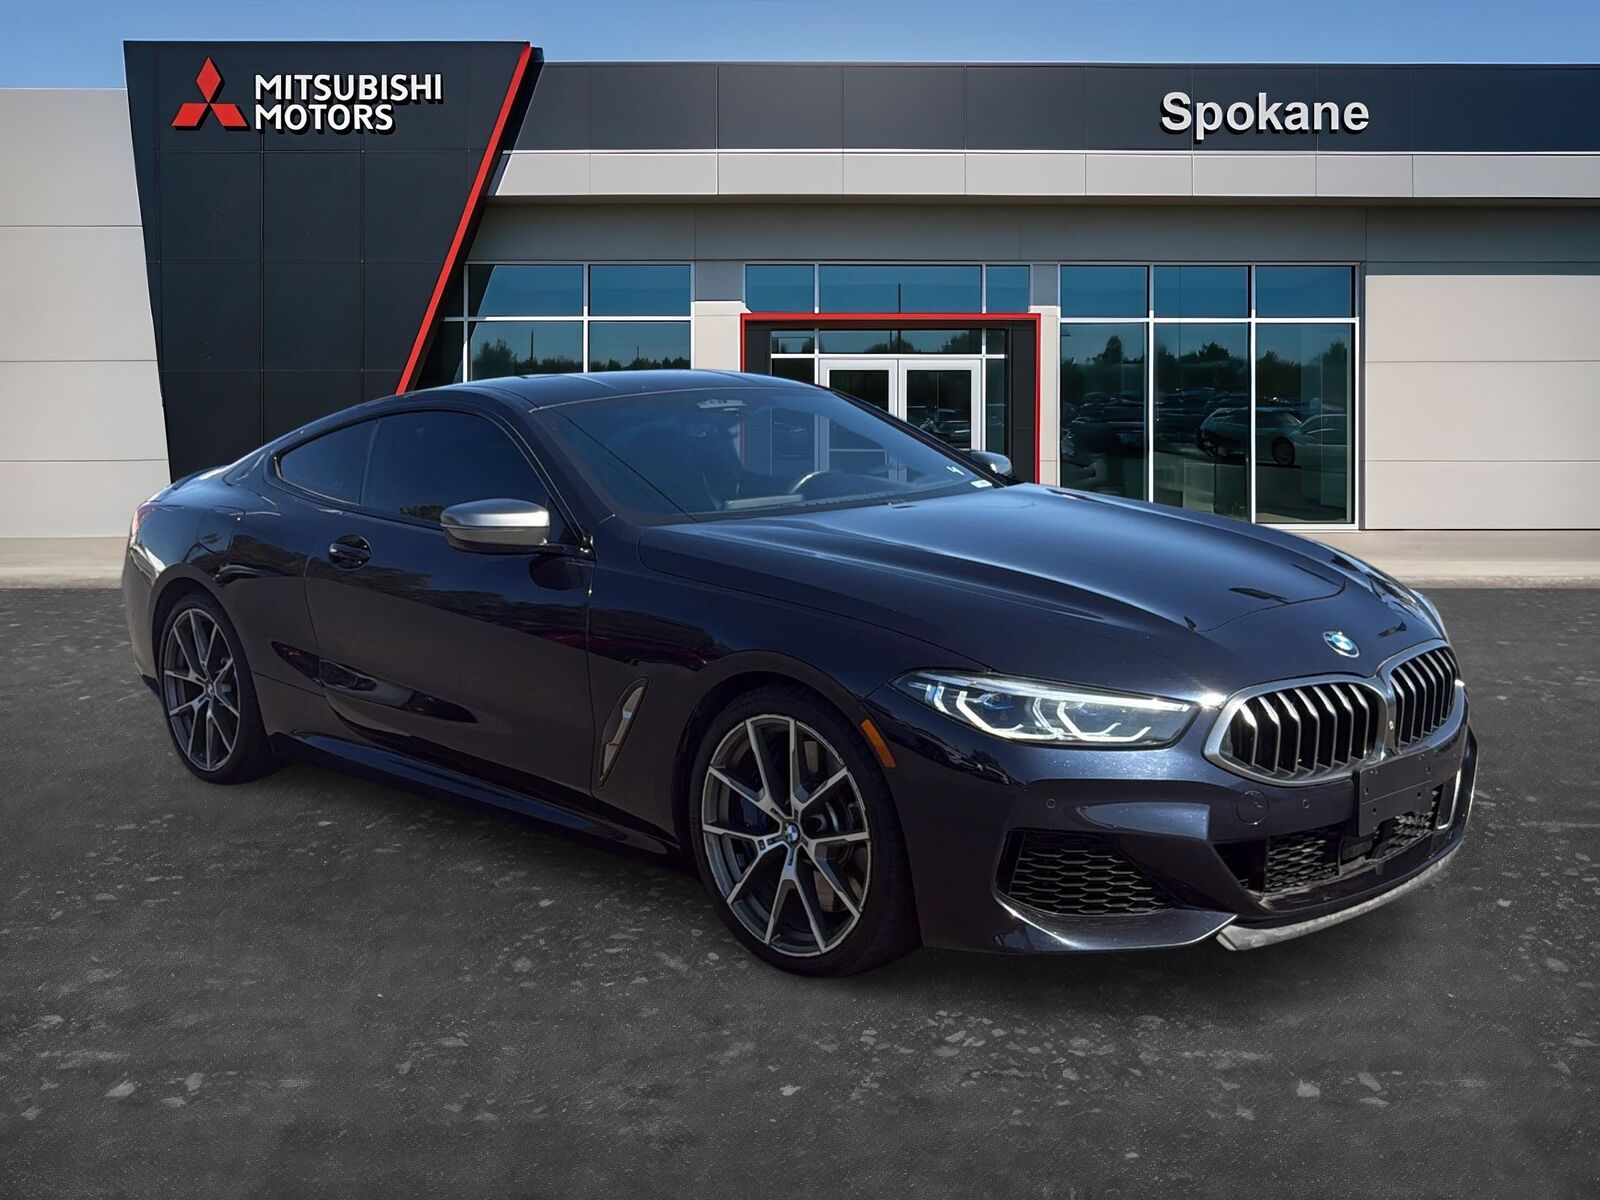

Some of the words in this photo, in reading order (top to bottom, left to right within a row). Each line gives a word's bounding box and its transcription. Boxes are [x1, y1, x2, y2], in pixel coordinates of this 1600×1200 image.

[254, 73, 443, 101] MITSUBISHI
[254, 103, 394, 131] MOTORS
[1160, 91, 1371, 141] Spokane
